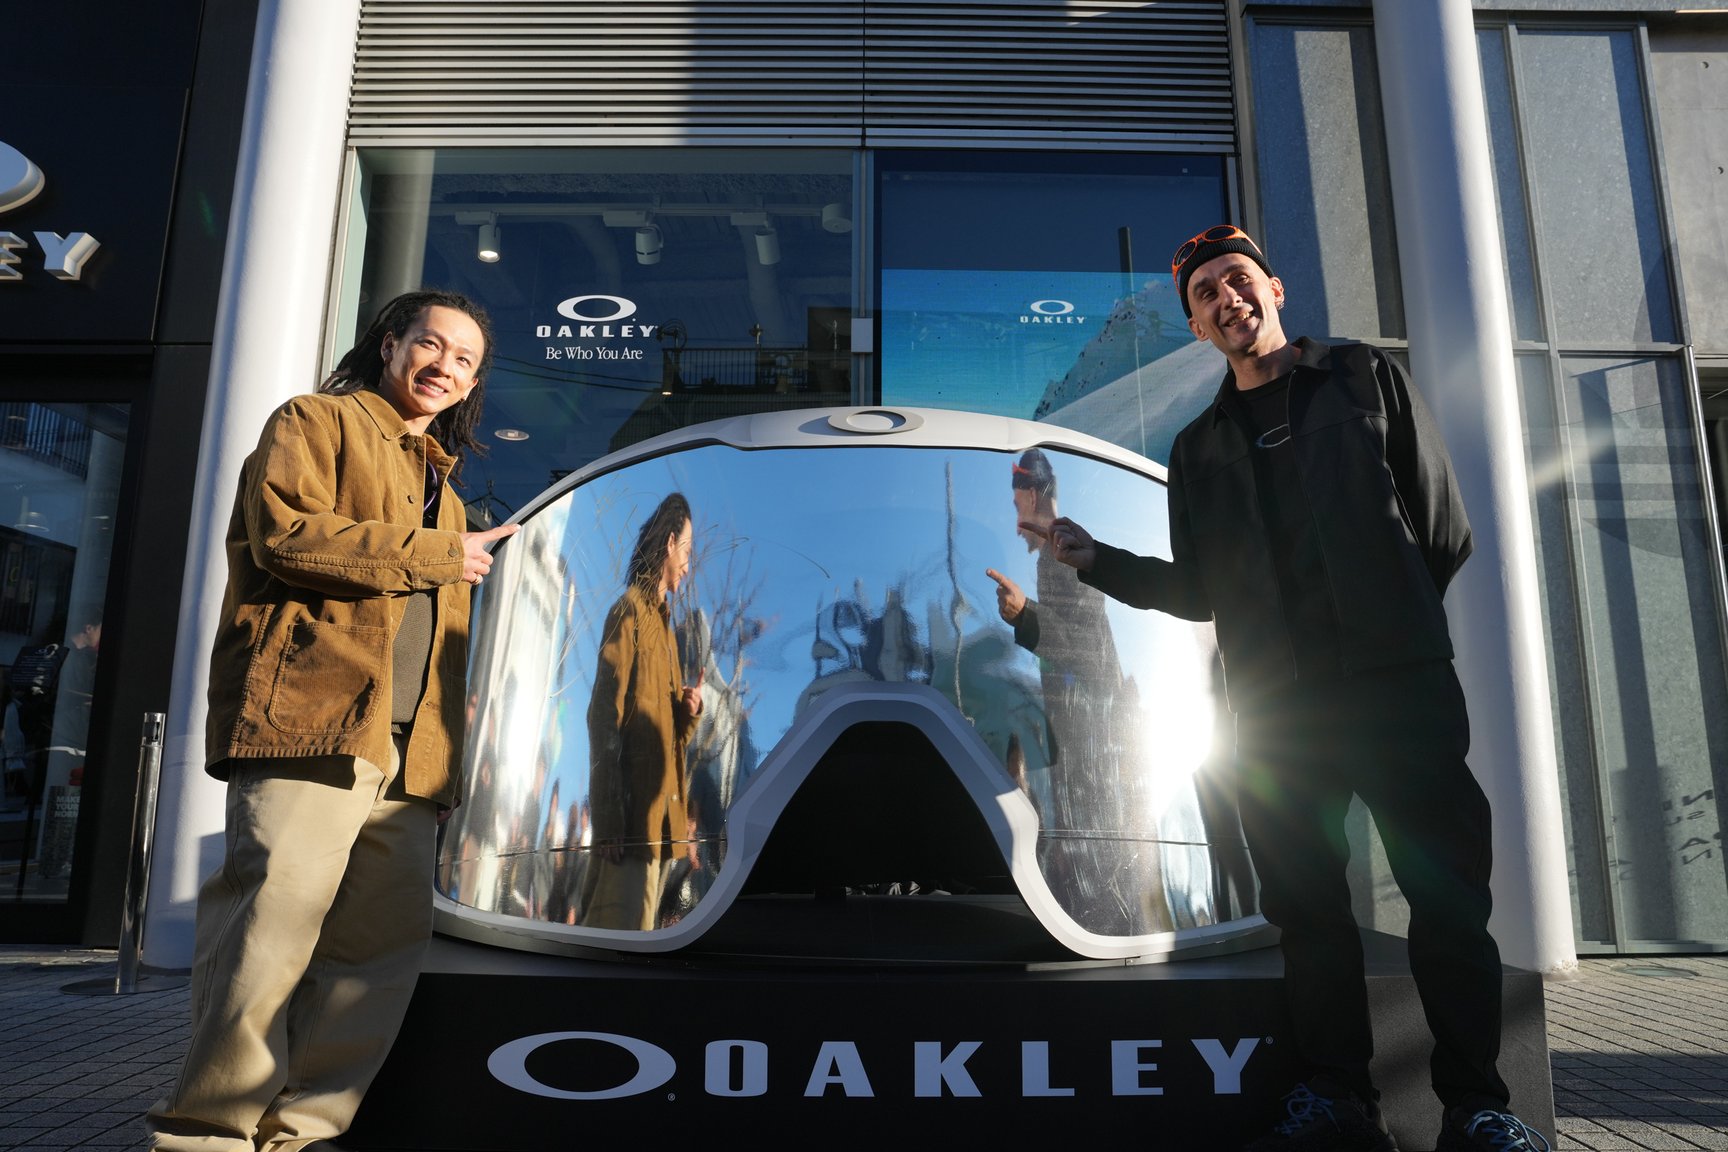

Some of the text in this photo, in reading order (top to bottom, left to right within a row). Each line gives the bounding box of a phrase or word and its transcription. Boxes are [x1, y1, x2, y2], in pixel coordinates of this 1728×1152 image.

[1020, 316, 1085, 324] OAKLEY
[536, 325, 655, 338] OAKLEY
[545, 346, 643, 360] Be Who You Are
[704, 1038, 1261, 1098] OAKLEY
